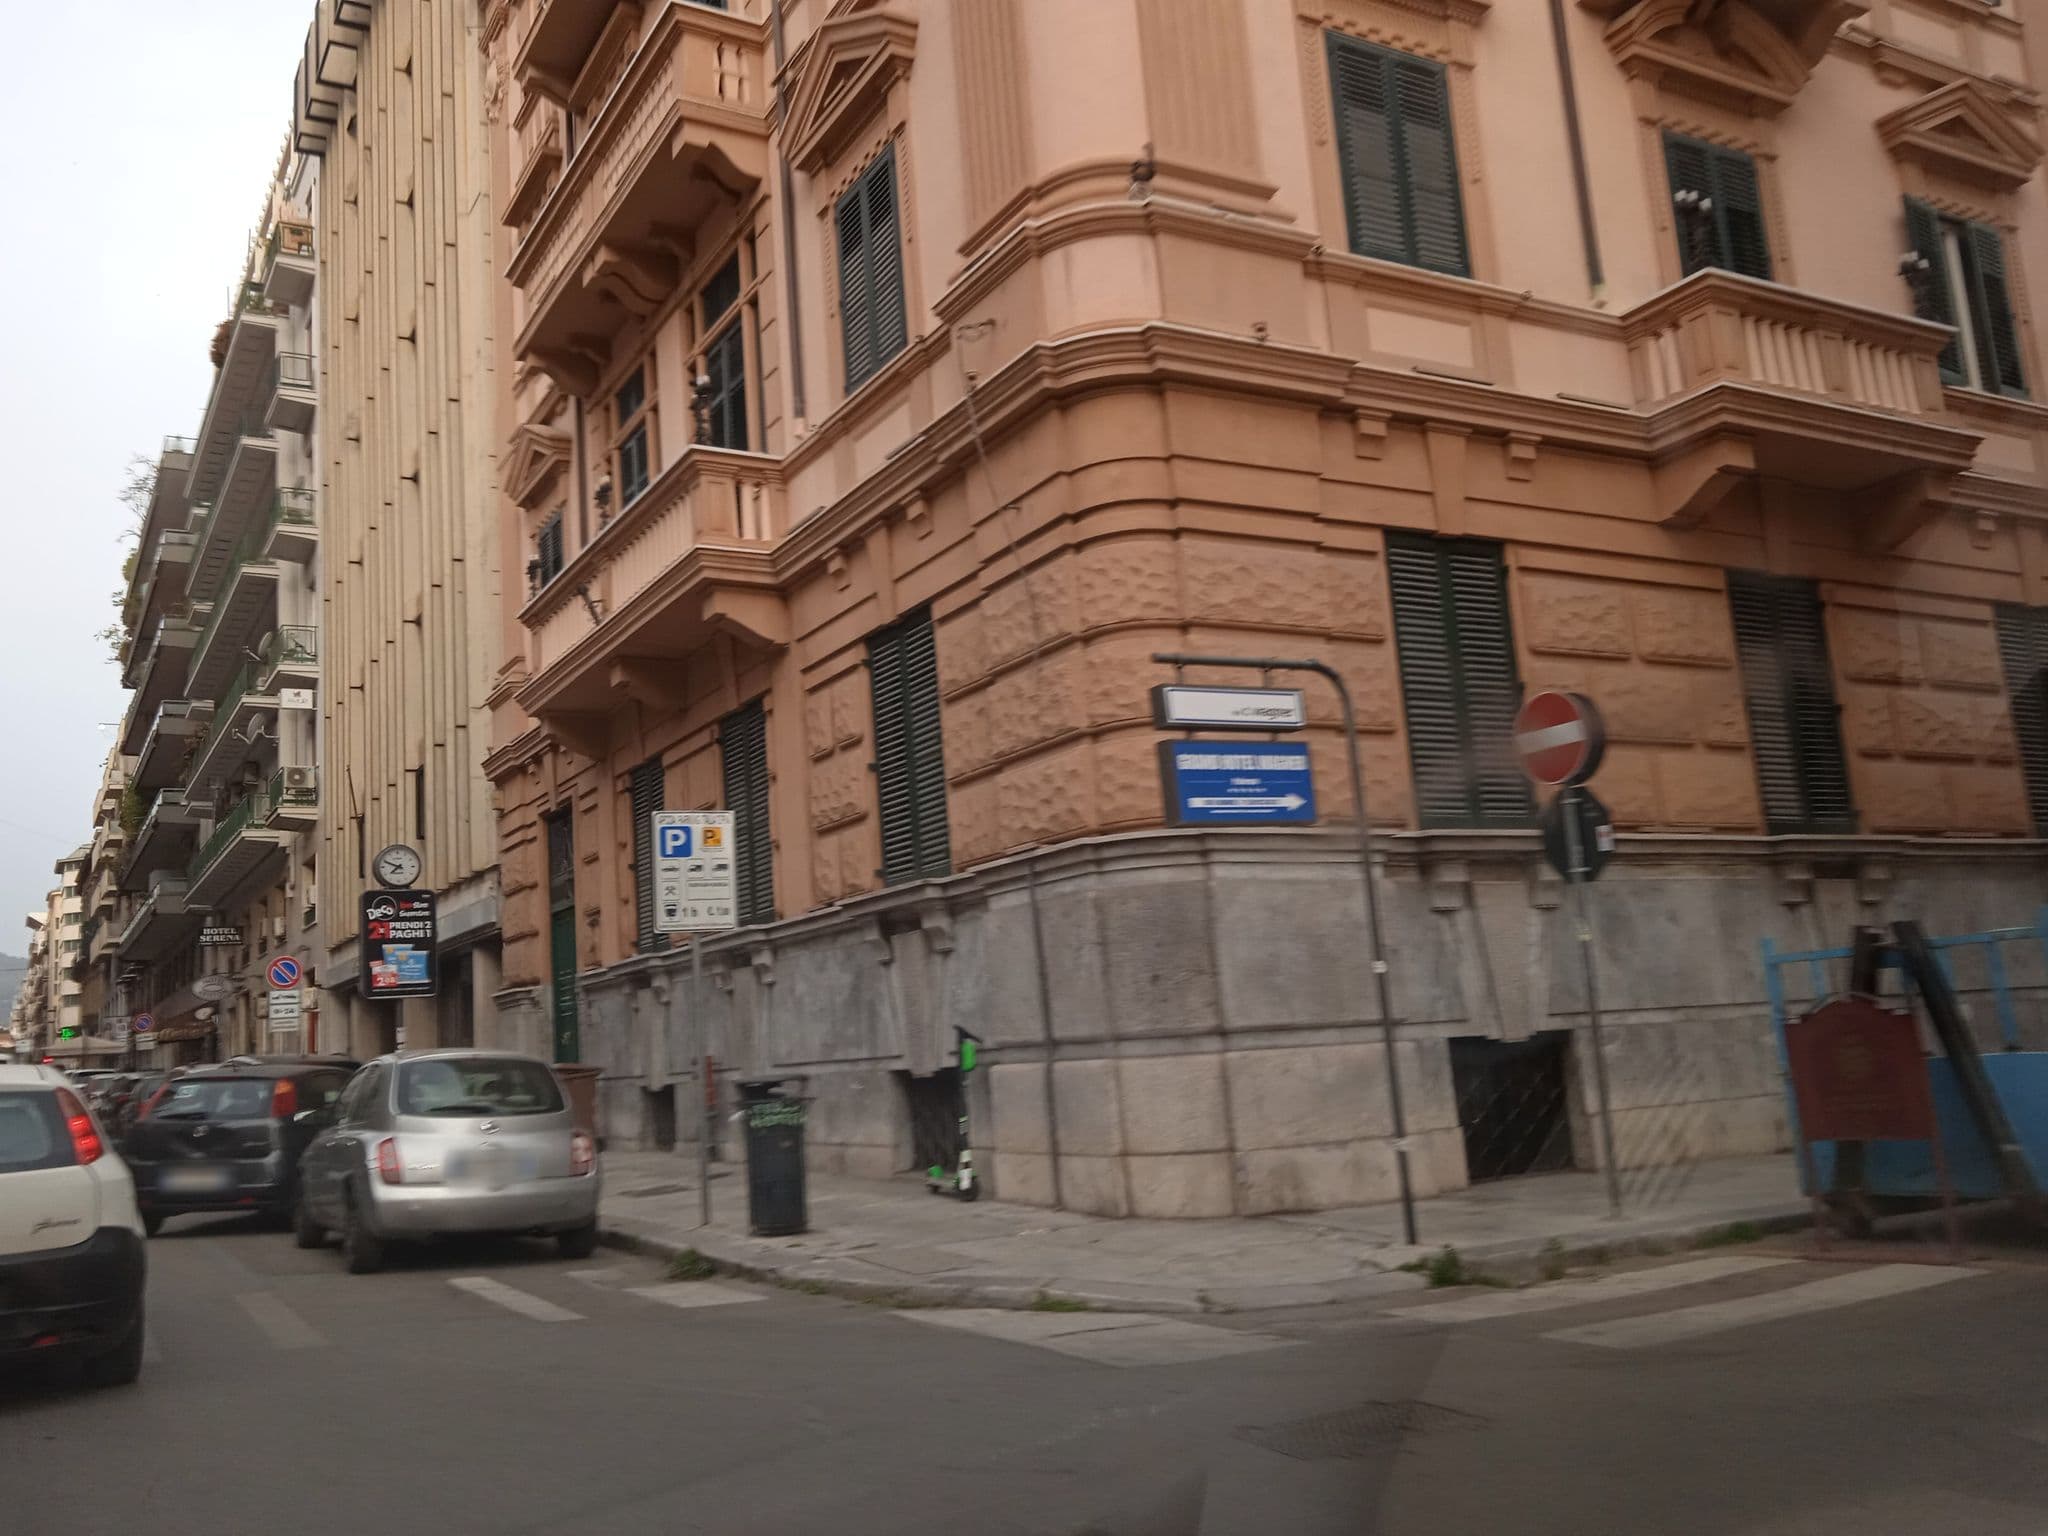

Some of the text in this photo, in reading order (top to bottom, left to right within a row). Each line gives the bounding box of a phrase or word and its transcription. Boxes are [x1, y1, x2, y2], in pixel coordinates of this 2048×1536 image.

[665, 829, 687, 855] P
[389, 920, 432, 930] PRENDI 2
[203, 927, 238, 935] HOTEL
[389, 929, 423, 938] PAGHI
[199, 934, 241, 943] SERENA
